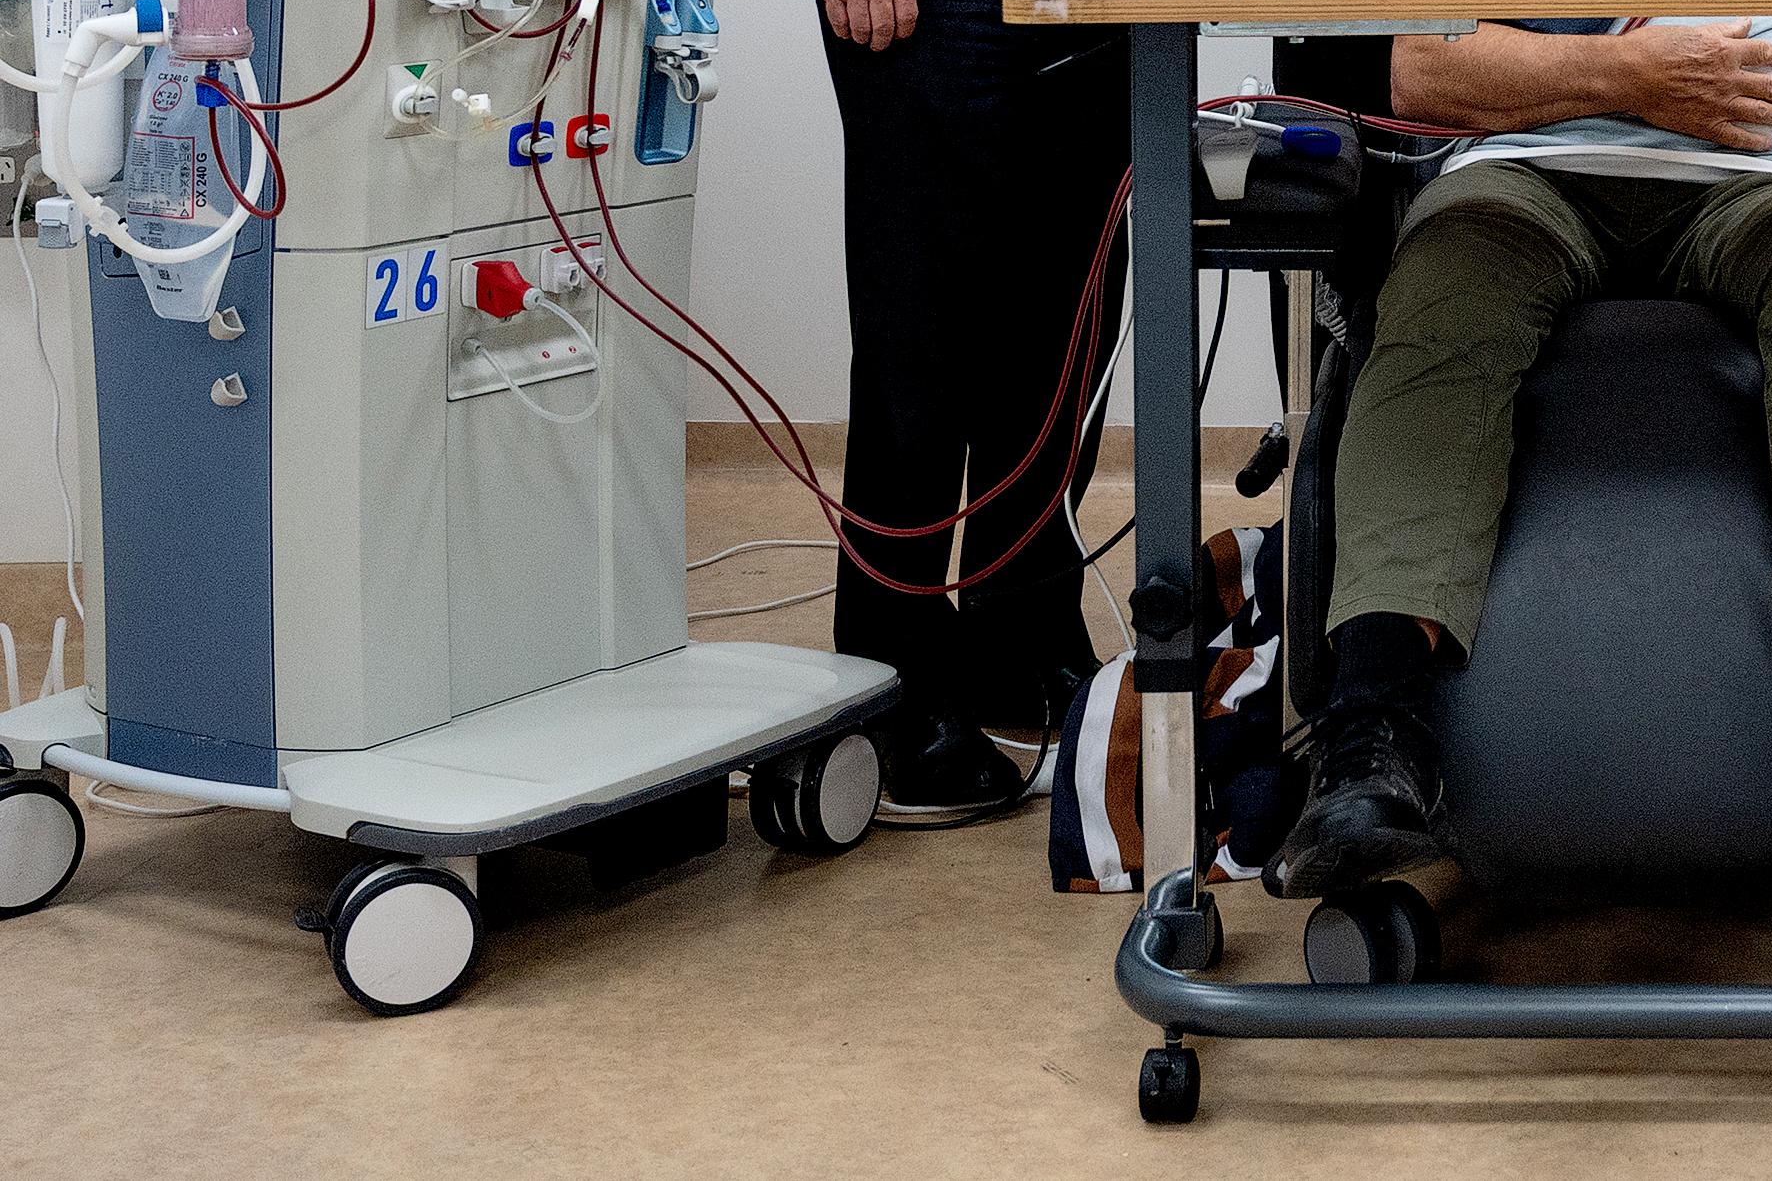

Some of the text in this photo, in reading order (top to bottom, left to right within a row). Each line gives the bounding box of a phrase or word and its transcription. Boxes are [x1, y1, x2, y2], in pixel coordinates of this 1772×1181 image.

[158, 72, 189, 83] CX 240 G
[195, 152, 207, 208] CX 240 G
[374, 249, 438, 322] 26
